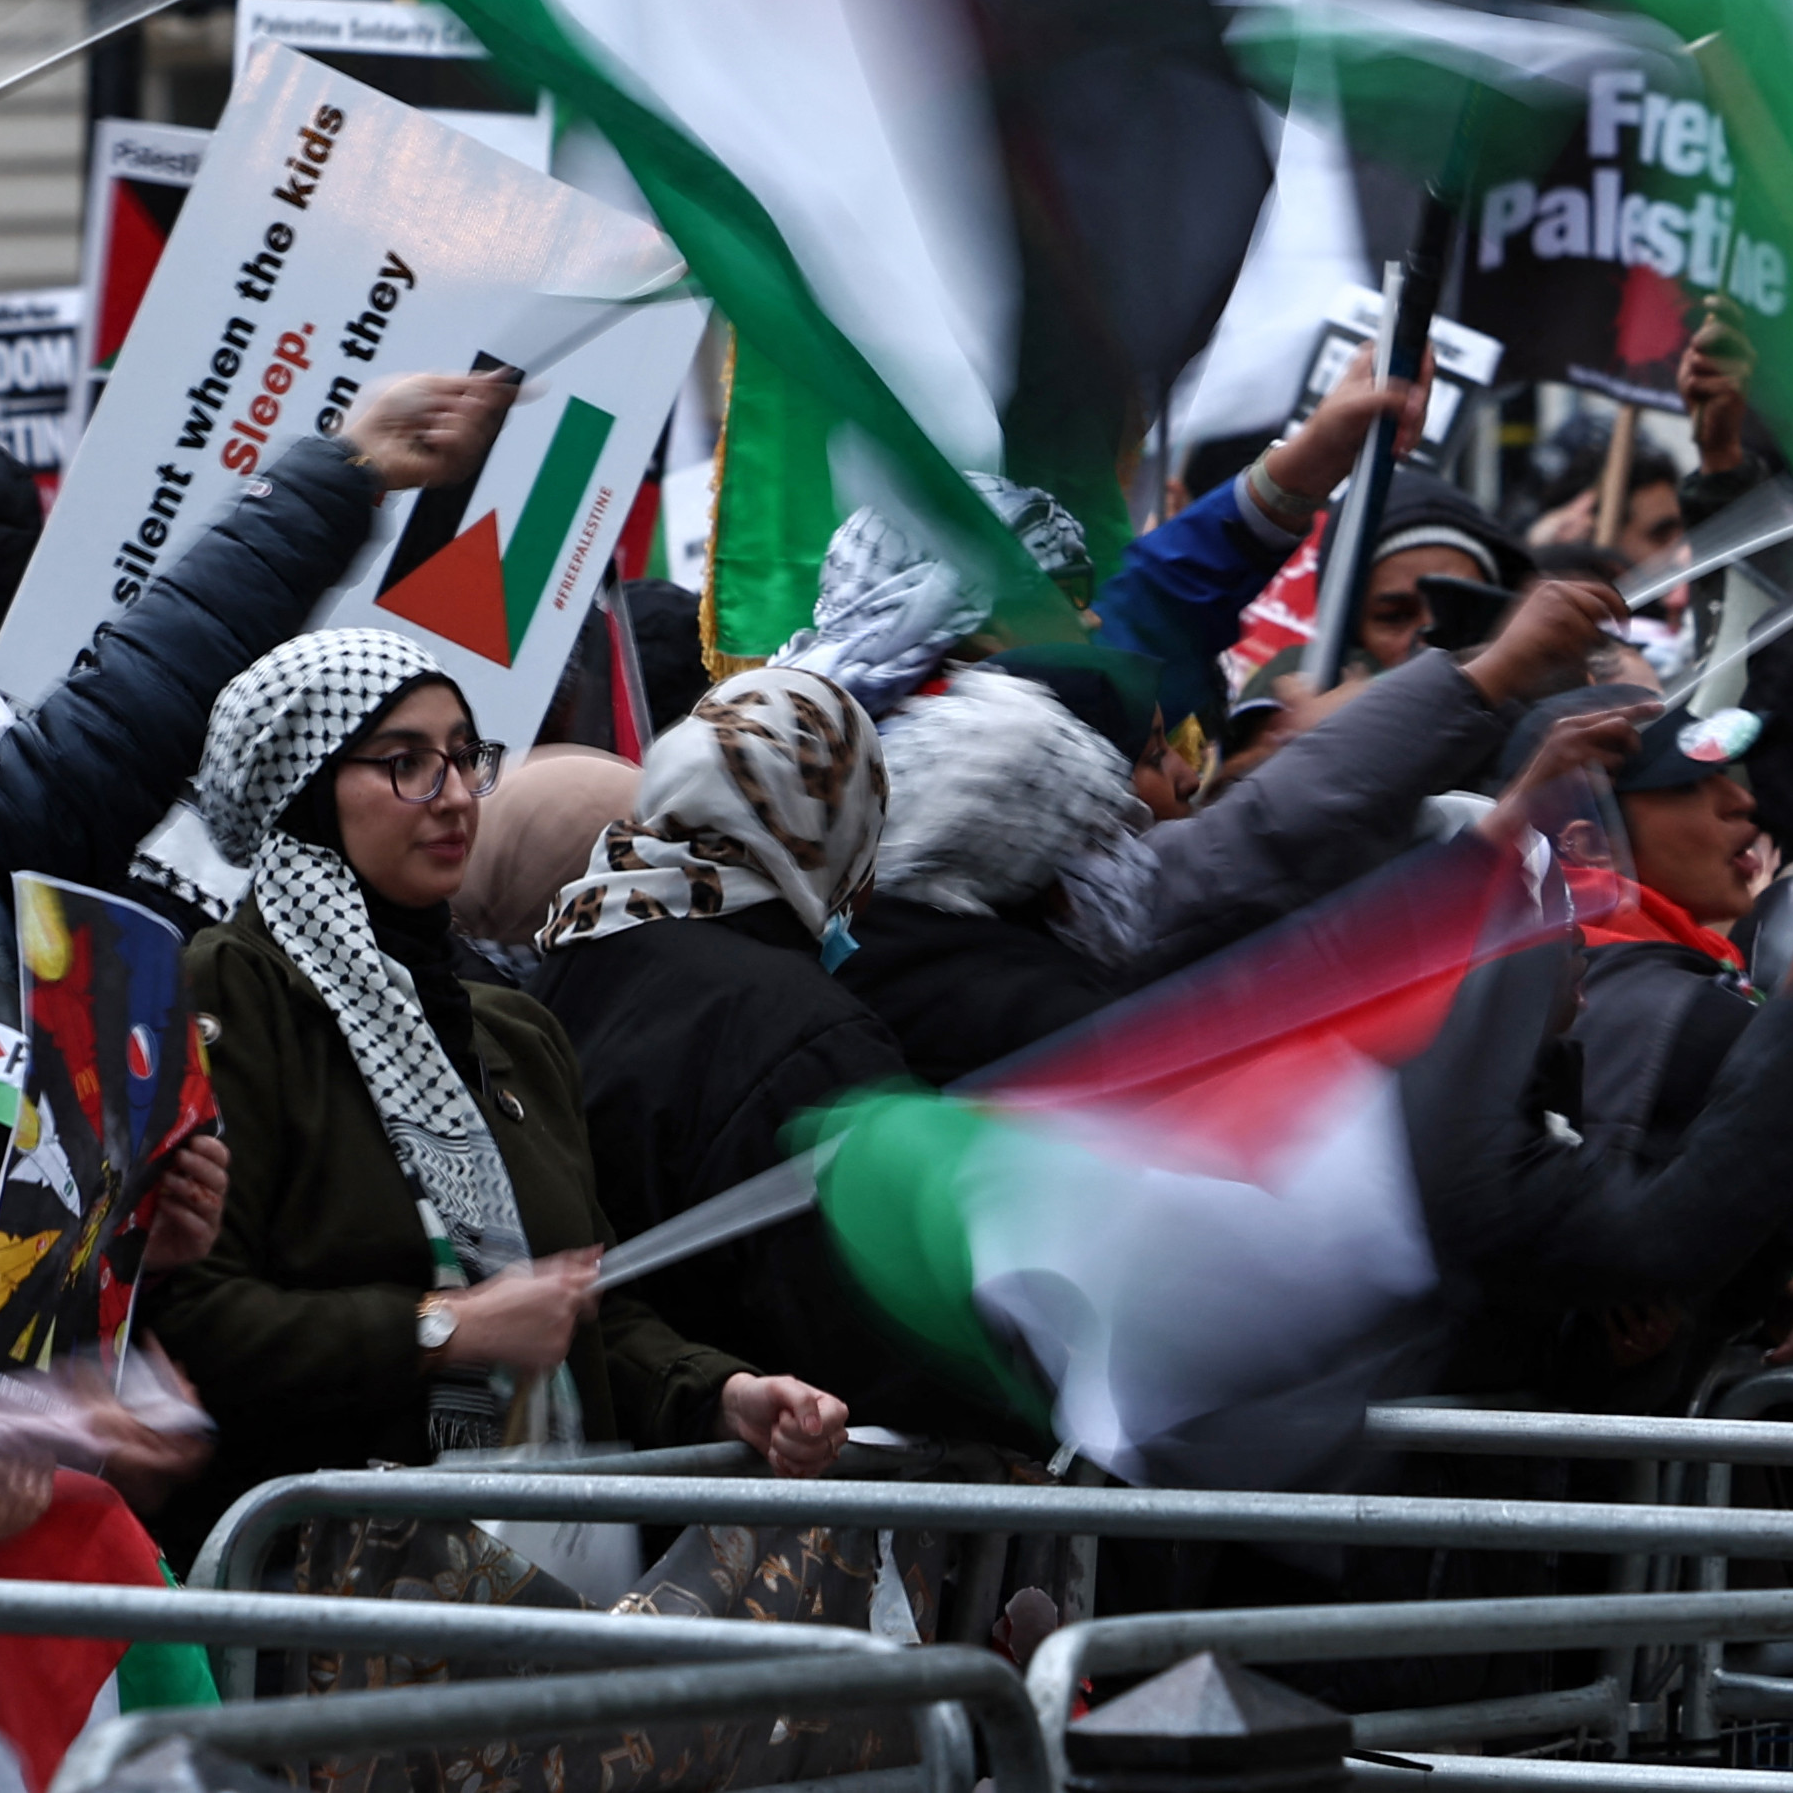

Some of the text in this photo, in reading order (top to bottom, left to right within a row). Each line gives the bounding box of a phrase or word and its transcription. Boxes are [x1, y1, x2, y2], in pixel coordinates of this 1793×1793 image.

[1586, 69, 1736, 187] Free
[337, 249, 419, 365] they
[1477, 168, 1788, 318] Palestine
[111, 102, 348, 609] silent when the kids
[219, 321, 316, 477] Sleep.
[552, 485, 614, 612] #FREEPALESTINE
